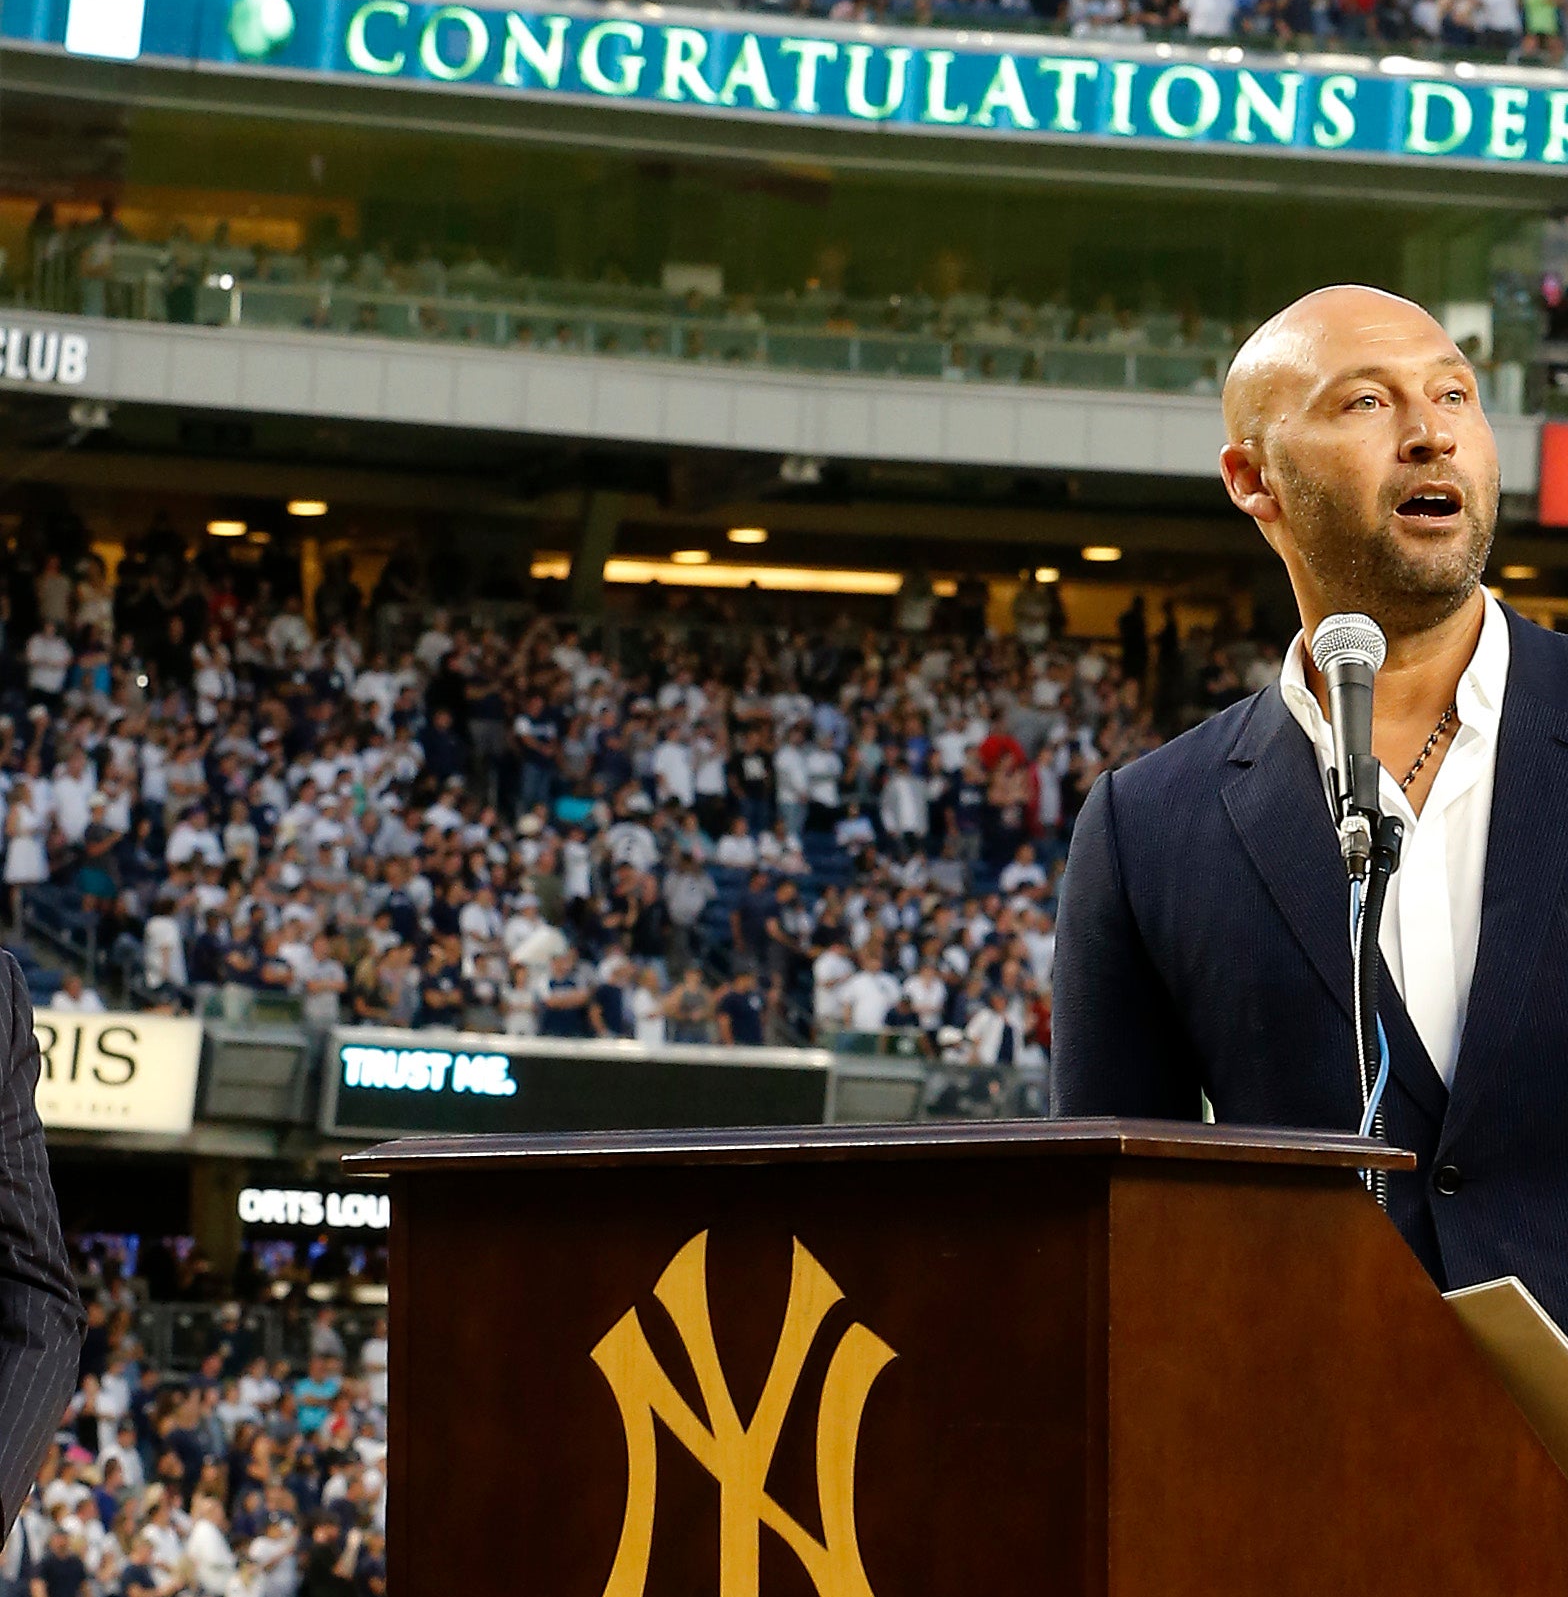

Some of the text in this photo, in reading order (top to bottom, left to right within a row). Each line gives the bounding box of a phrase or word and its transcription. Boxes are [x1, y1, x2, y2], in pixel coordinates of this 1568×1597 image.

[345, 0, 1358, 150] CONGRATULATIONS
[0, 327, 88, 384] LUB
[341, 1046, 517, 1096] TRUST ME.
[238, 1188, 324, 1226] ORTS
